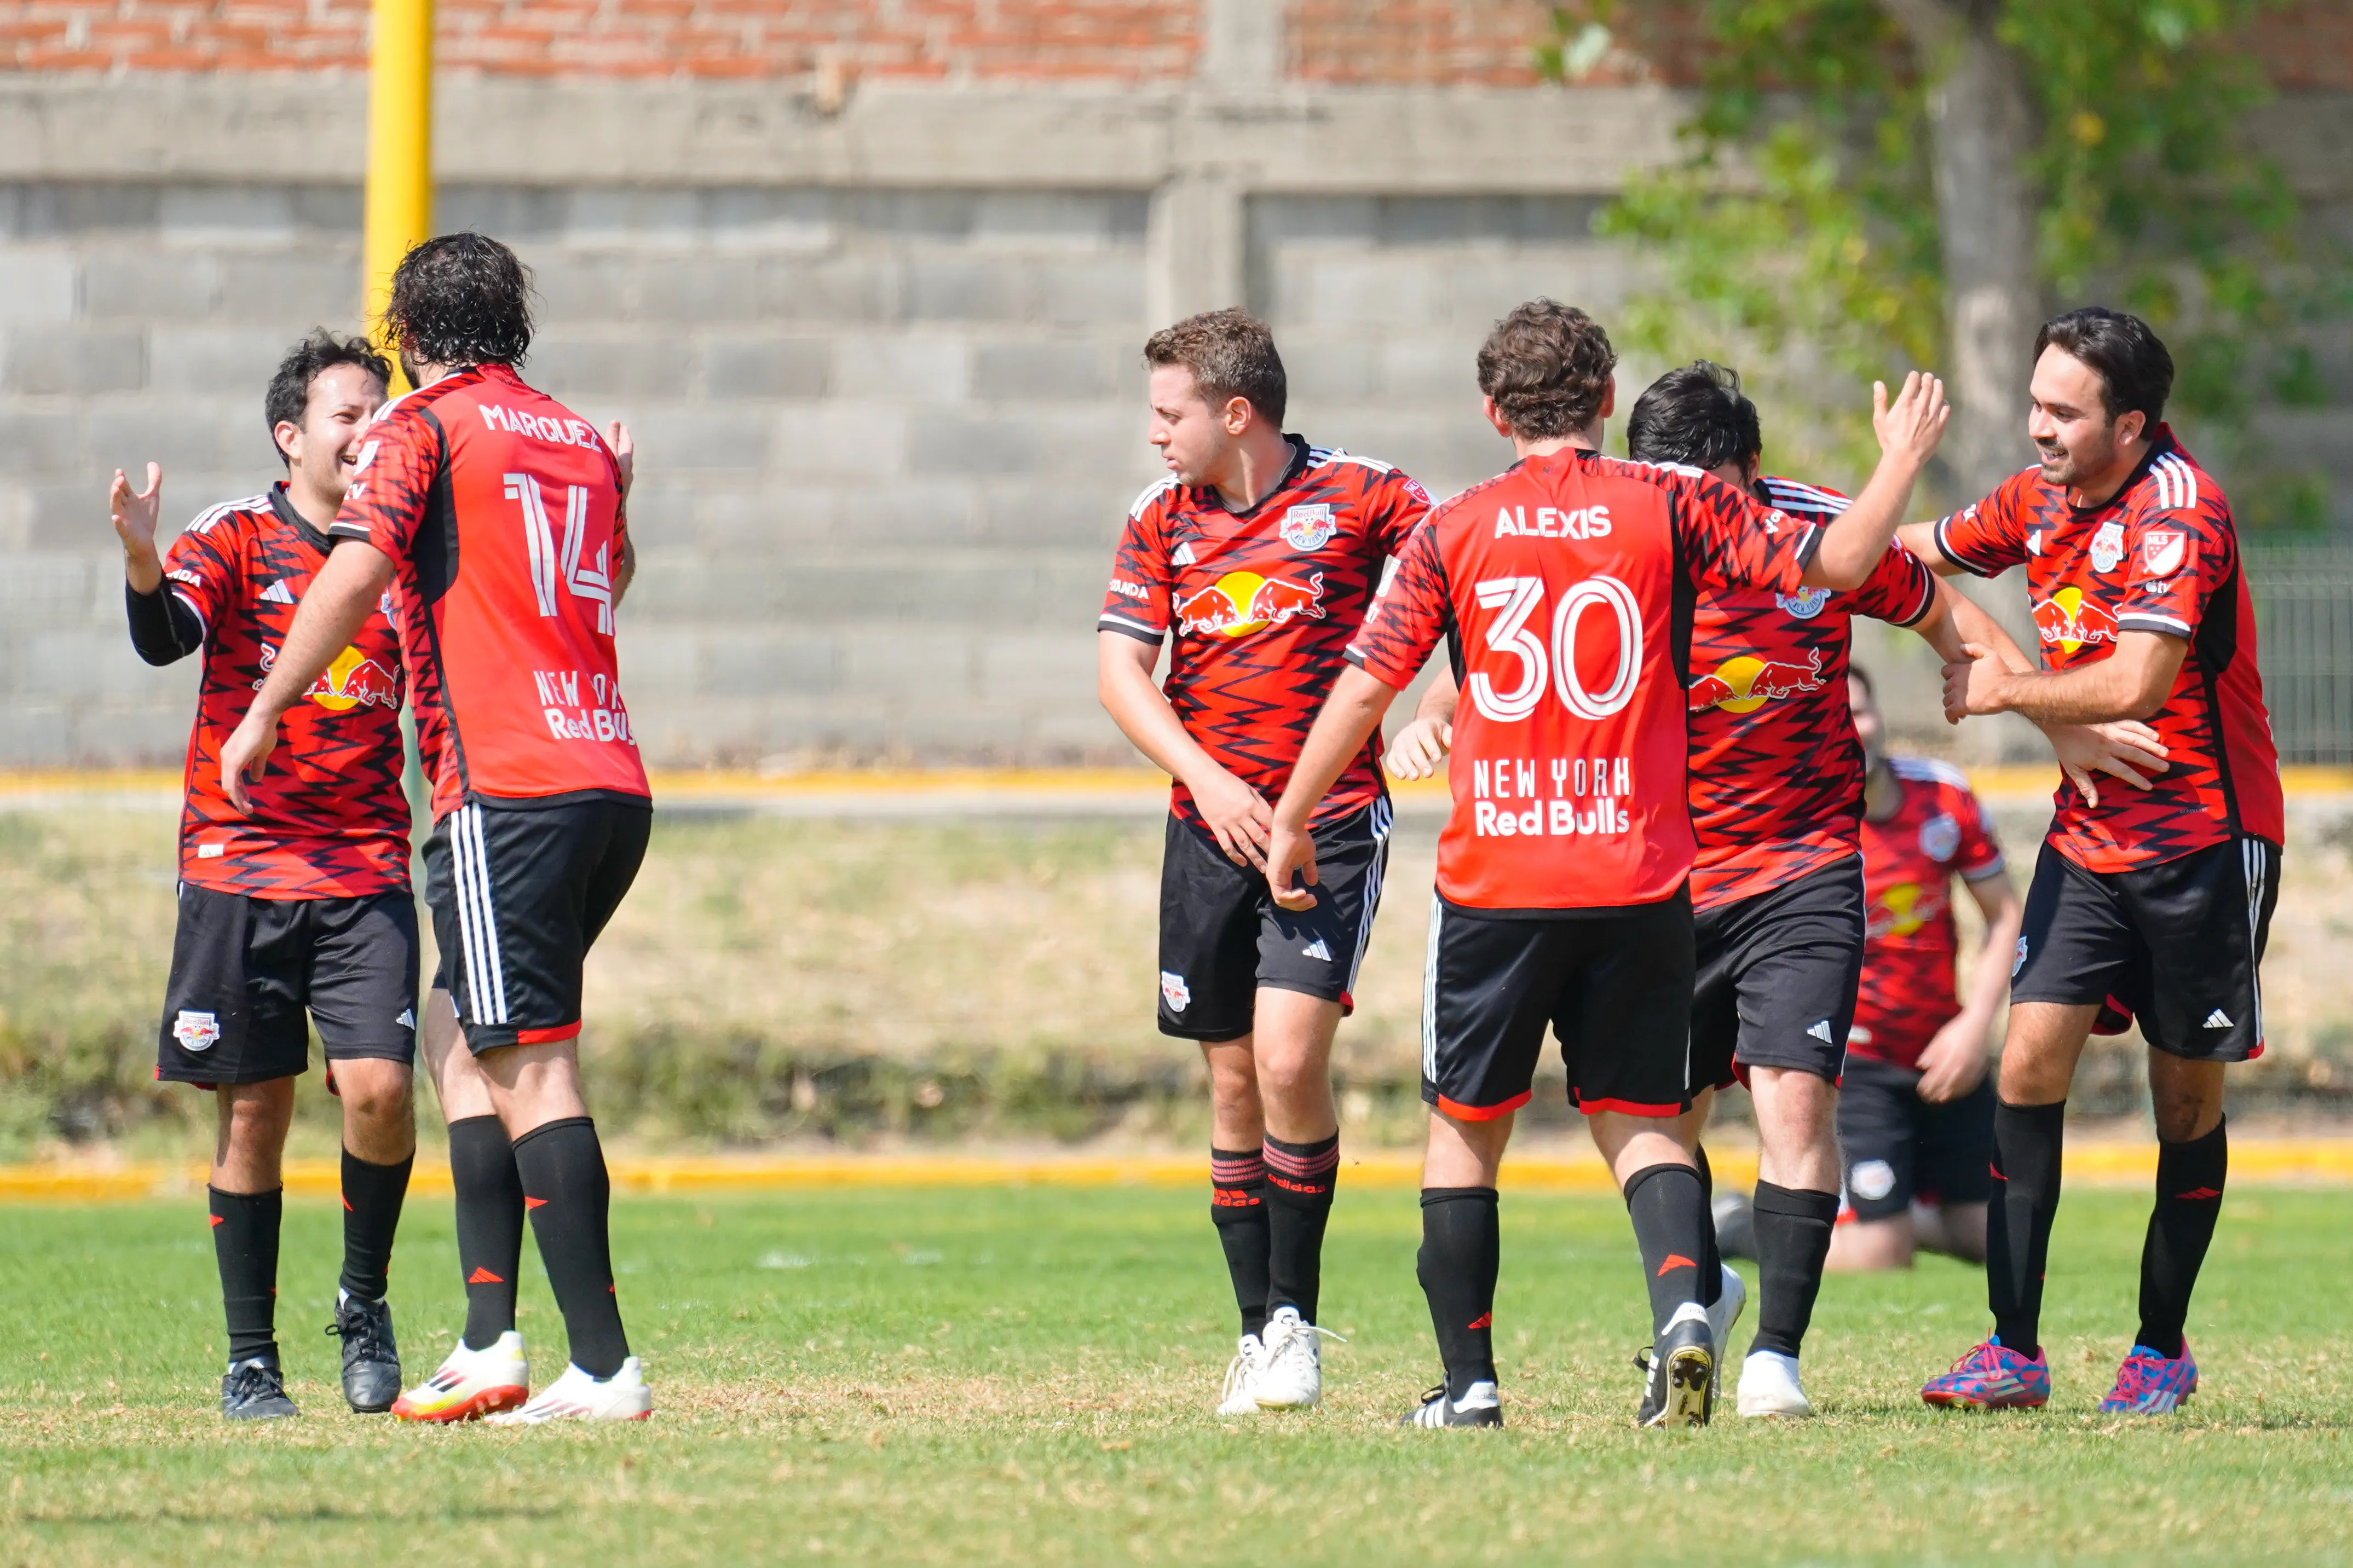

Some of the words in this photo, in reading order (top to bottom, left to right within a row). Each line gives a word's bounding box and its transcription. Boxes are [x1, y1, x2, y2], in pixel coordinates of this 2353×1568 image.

[478, 404, 603, 453] MARQUEZ
[1494, 505, 1612, 540] ALEXIS
[2148, 535, 2169, 545] MLS
[503, 473, 614, 637] 14
[1469, 576, 1643, 722] 30
[533, 670, 580, 707] NEW
[544, 708, 595, 740] Red
[1474, 759, 1536, 799] NEW
[1551, 757, 1630, 798] YORK
[1474, 799, 1543, 837] Red
[1549, 797, 1630, 836] Bulls
